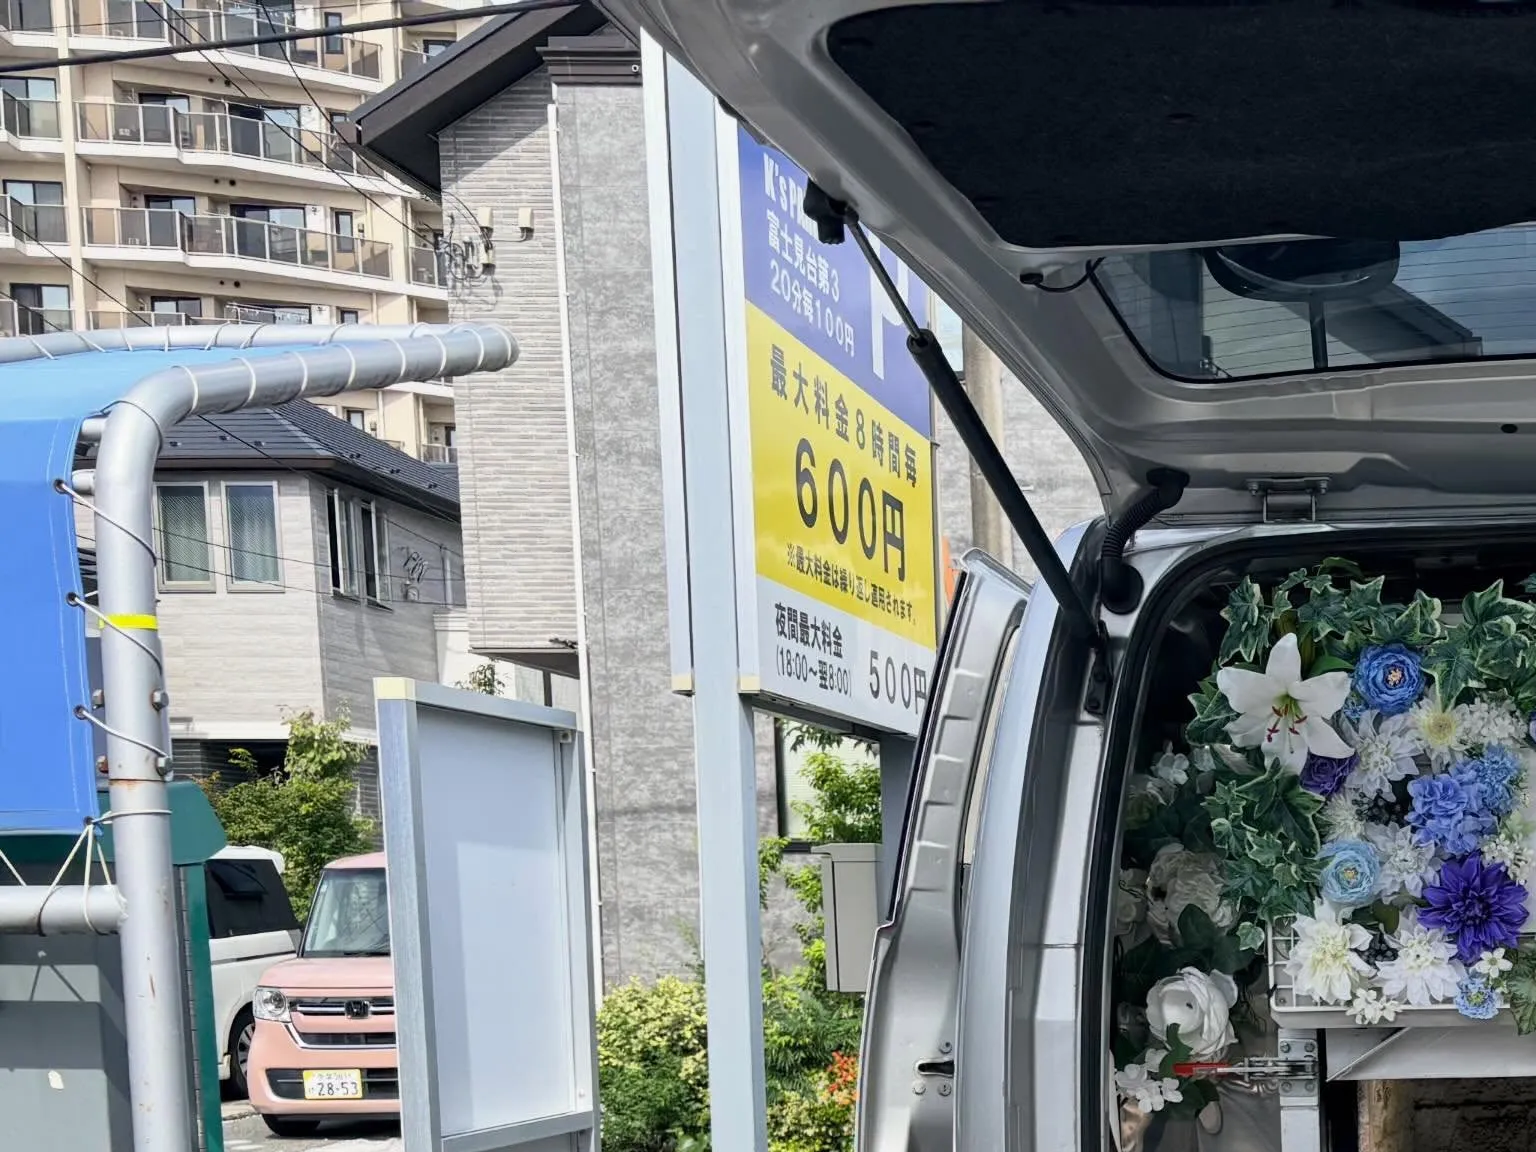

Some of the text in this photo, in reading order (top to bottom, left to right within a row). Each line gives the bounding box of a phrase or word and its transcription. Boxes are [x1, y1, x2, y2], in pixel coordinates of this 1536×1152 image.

[766, 208, 840, 303] 富士見台第3
[769, 259, 855, 357] 20分毎100円
[770, 343, 917, 489] 最大料金8時間毎
[795, 438, 906, 582] 600円
[775, 602, 843, 659] 夜間最大料金
[869, 650, 928, 715] 500円
